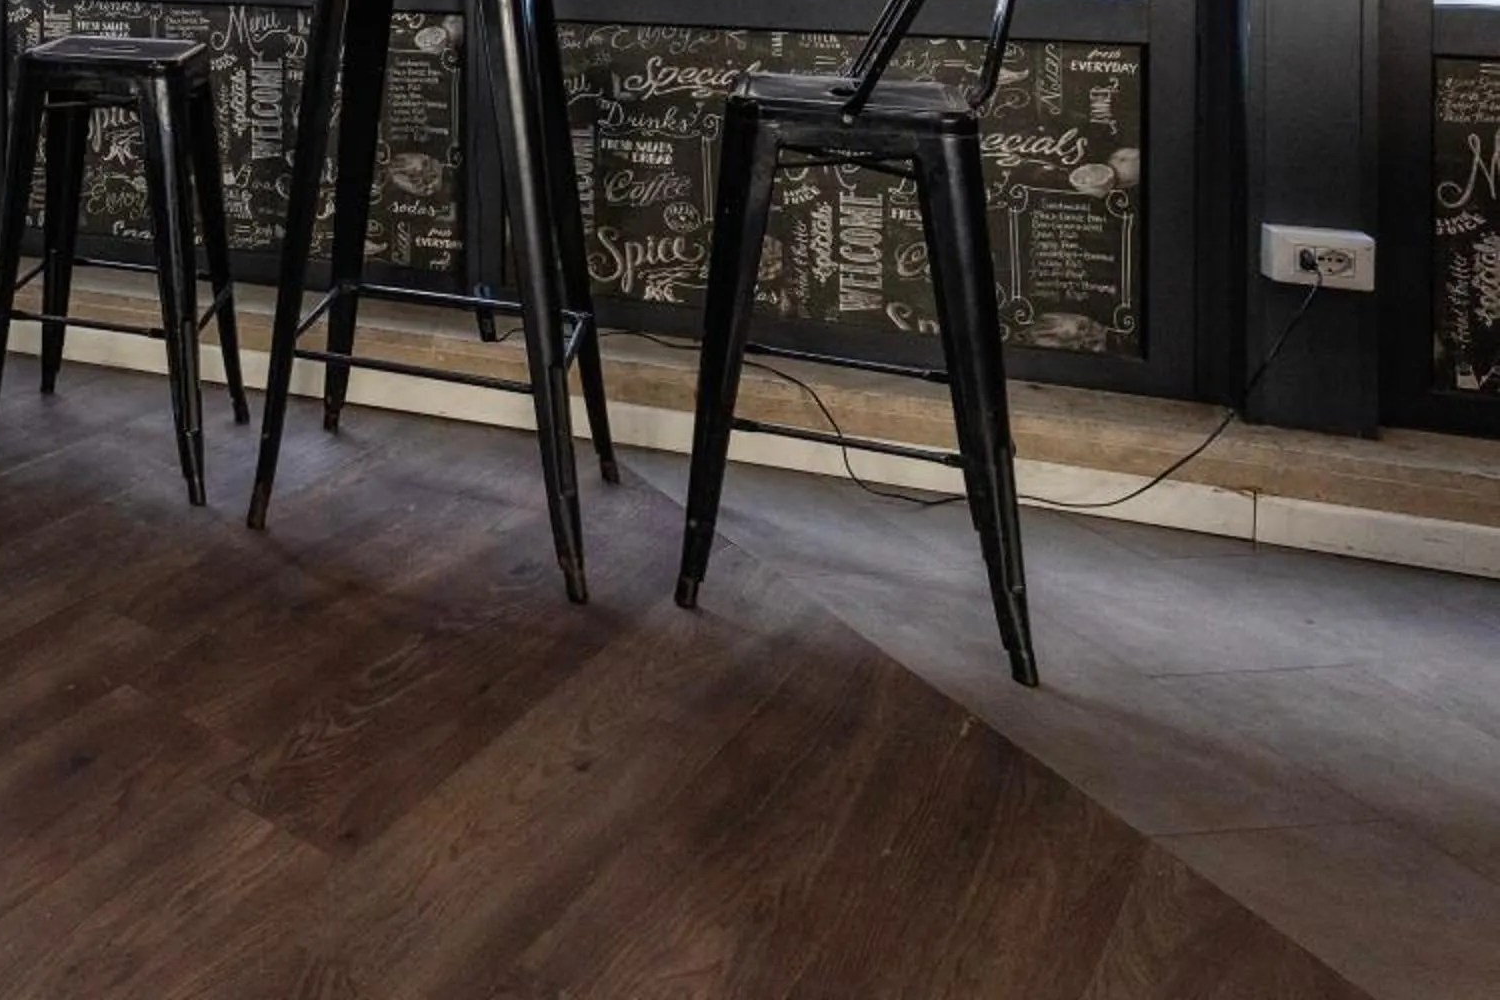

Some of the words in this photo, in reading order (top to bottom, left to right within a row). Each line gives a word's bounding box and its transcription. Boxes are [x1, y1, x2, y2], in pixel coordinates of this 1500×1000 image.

[211, 6, 290, 58] Menu
[624, 56, 762, 98] Specia
[1070, 59, 1138, 73] EVERYDAY
[251, 56, 283, 159] WELCOME
[598, 98, 694, 132] Drinks
[980, 127, 1089, 166] ecials
[604, 168, 693, 206] Coffee
[588, 226, 706, 294] Spice
[839, 191, 883, 311] WELCOME
